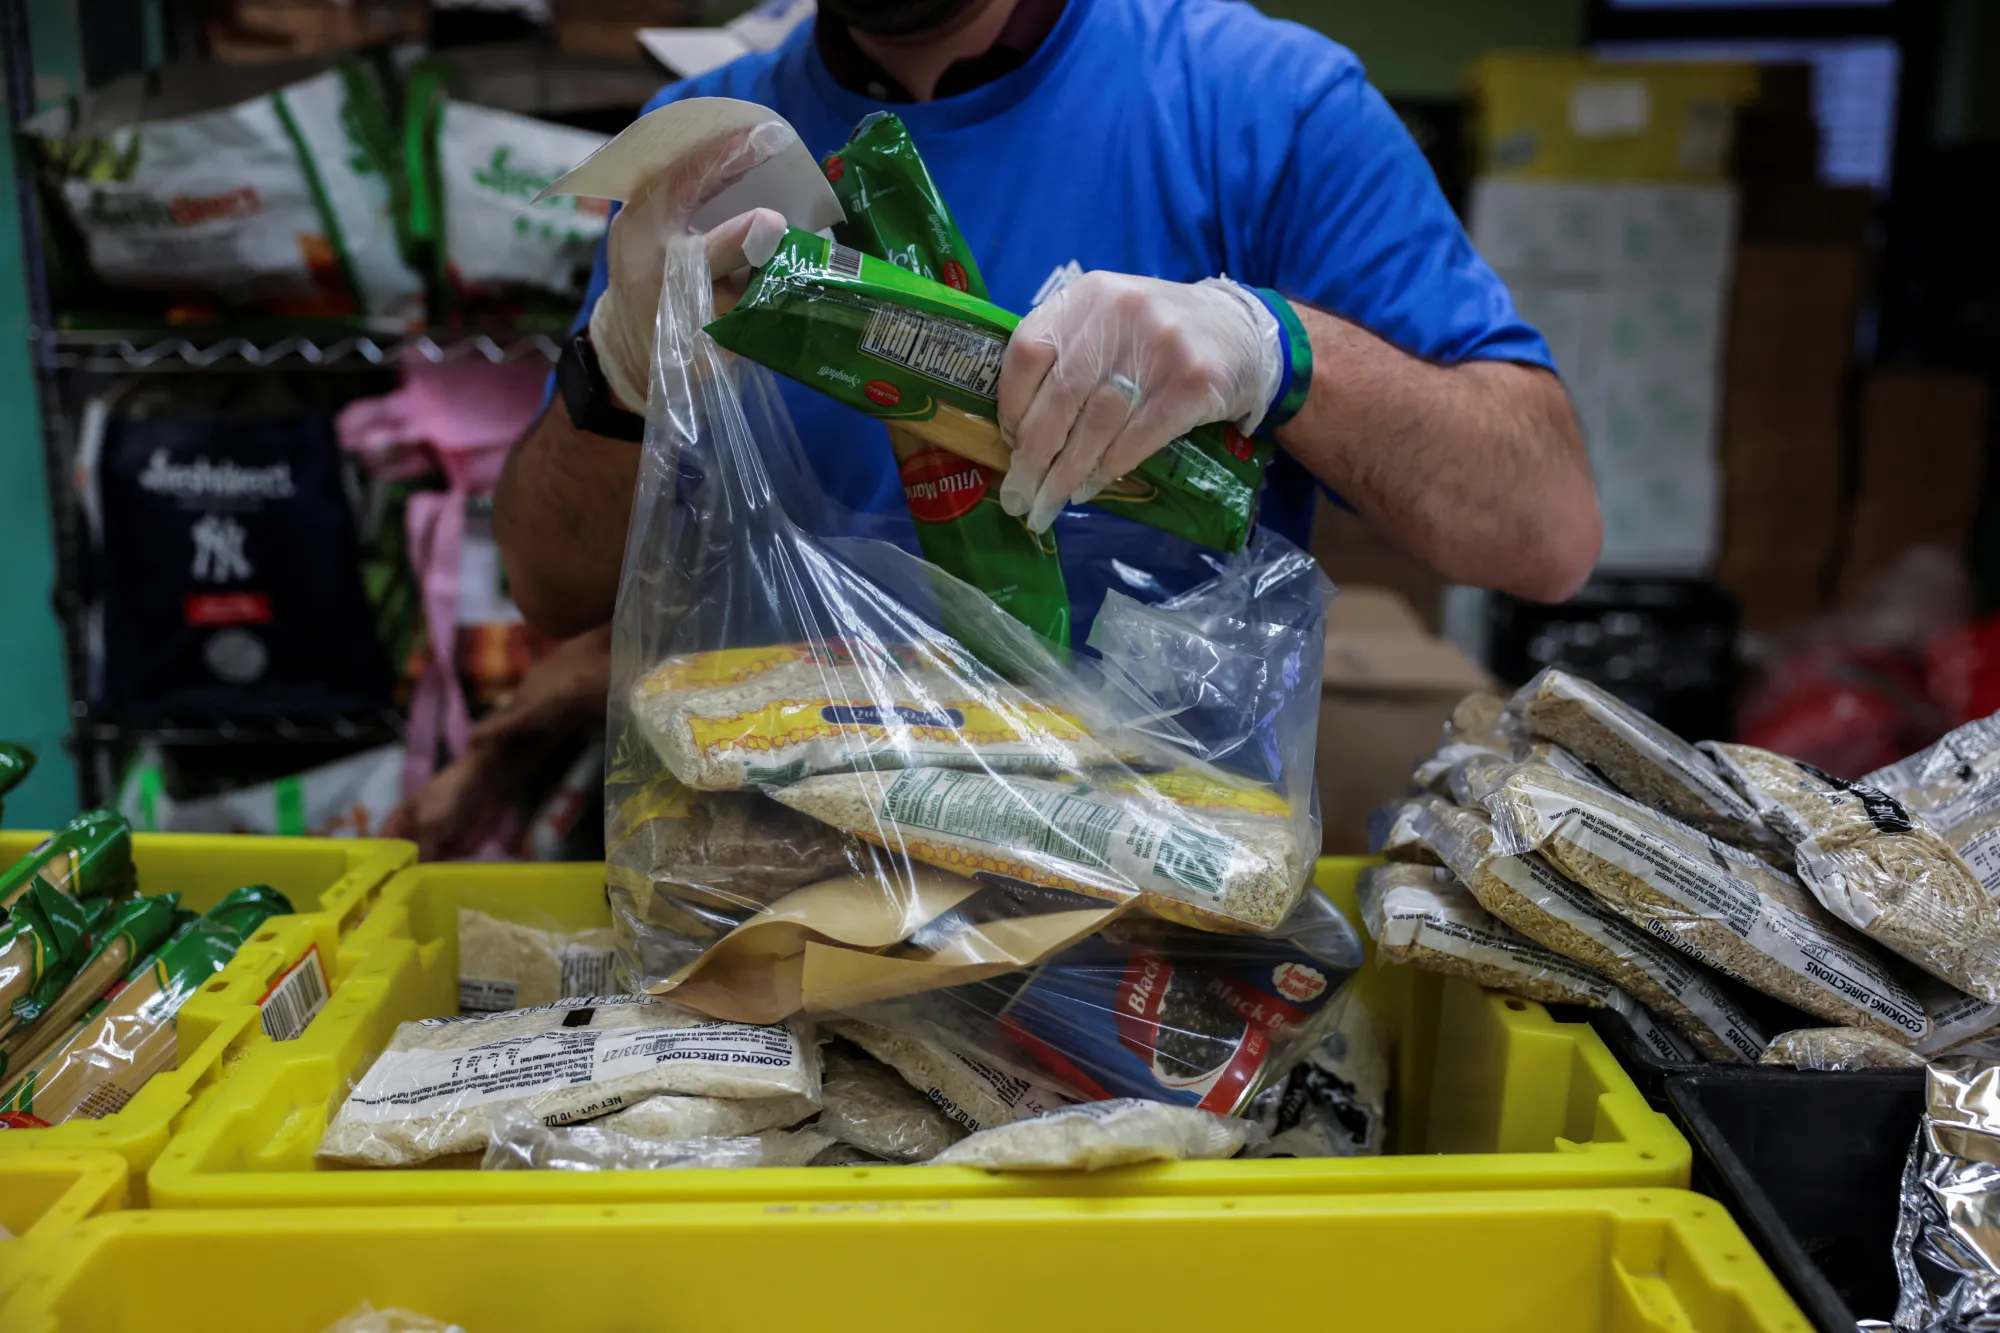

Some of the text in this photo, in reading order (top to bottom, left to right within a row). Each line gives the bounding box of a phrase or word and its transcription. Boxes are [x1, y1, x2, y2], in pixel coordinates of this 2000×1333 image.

[815, 363, 861, 388] Spaghetti
[938, 468, 982, 493] Villa
[883, 778, 908, 818] Nutrition
[1646, 918, 1680, 945] (454g)
[1679, 941, 1693, 955] OZ
[1693, 950, 1706, 962] 16
[1123, 959, 1164, 1011] Black
[1804, 960, 1869, 1004] DIRECTIONS
[1207, 976, 1266, 1021] Black
[1869, 997, 1922, 1034] COOKING
[655, 1050, 790, 1067] COOKING DIRECTIONS
[574, 1103, 598, 1115] WT.
[601, 1095, 622, 1106] NET
[927, 1087, 979, 1130] 16 OZ (454g)
